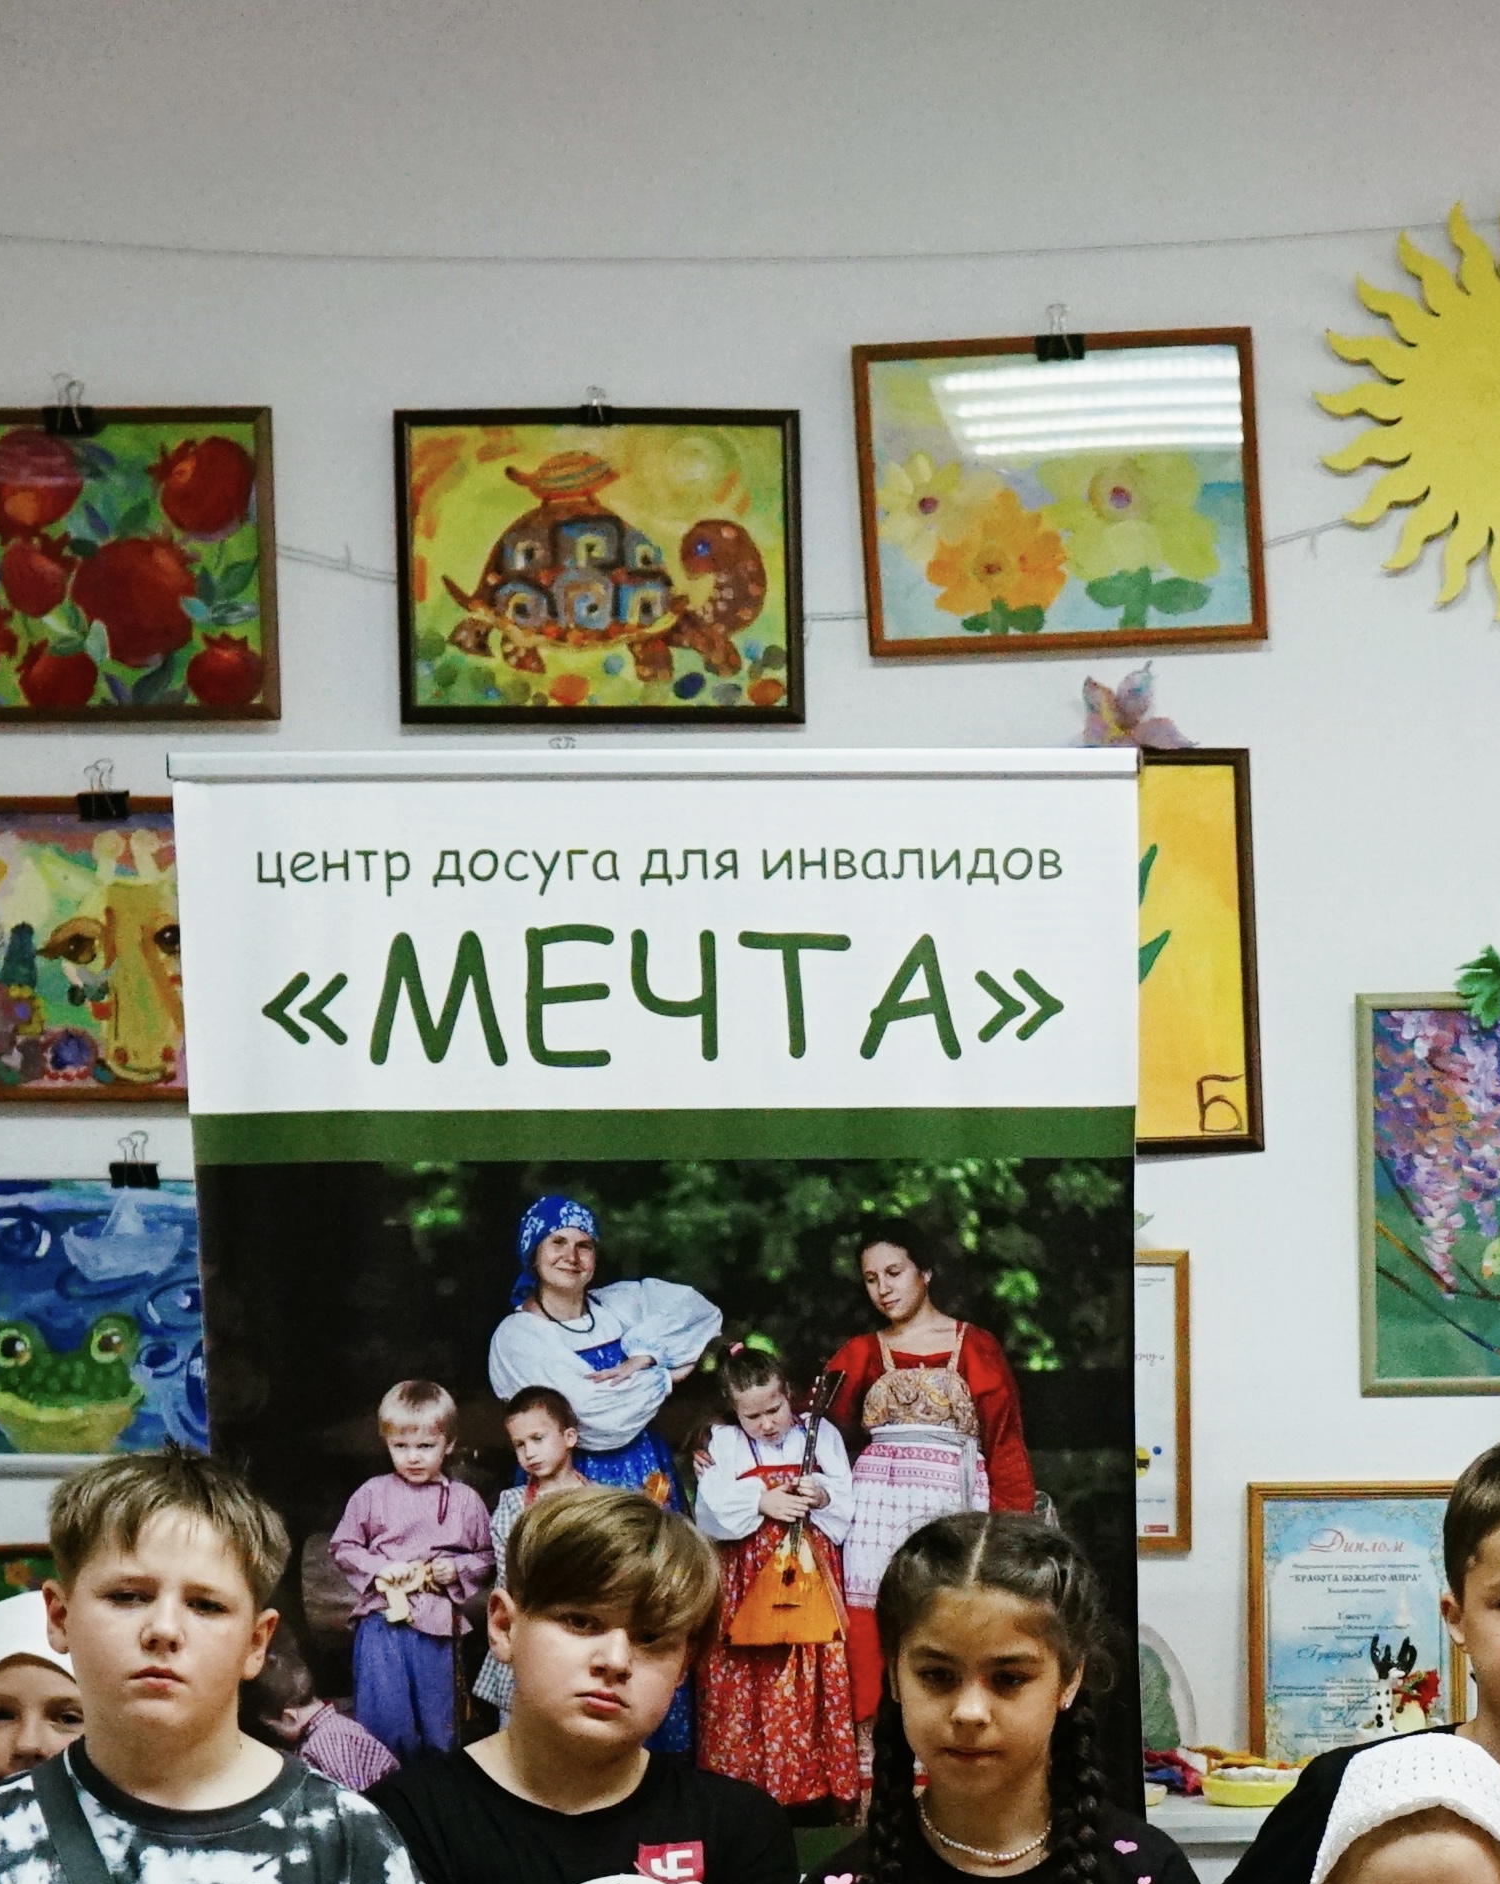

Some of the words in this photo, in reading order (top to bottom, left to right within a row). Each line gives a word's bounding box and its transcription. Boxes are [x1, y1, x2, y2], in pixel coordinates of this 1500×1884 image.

[256, 848, 411, 894] центр
[432, 848, 621, 896] досуга
[640, 850, 738, 886] для
[762, 843, 1063, 886] инвалидов
[262, 923, 1065, 1068] «МЕЧТА»
[1309, 1528, 1406, 1553] Диплом
